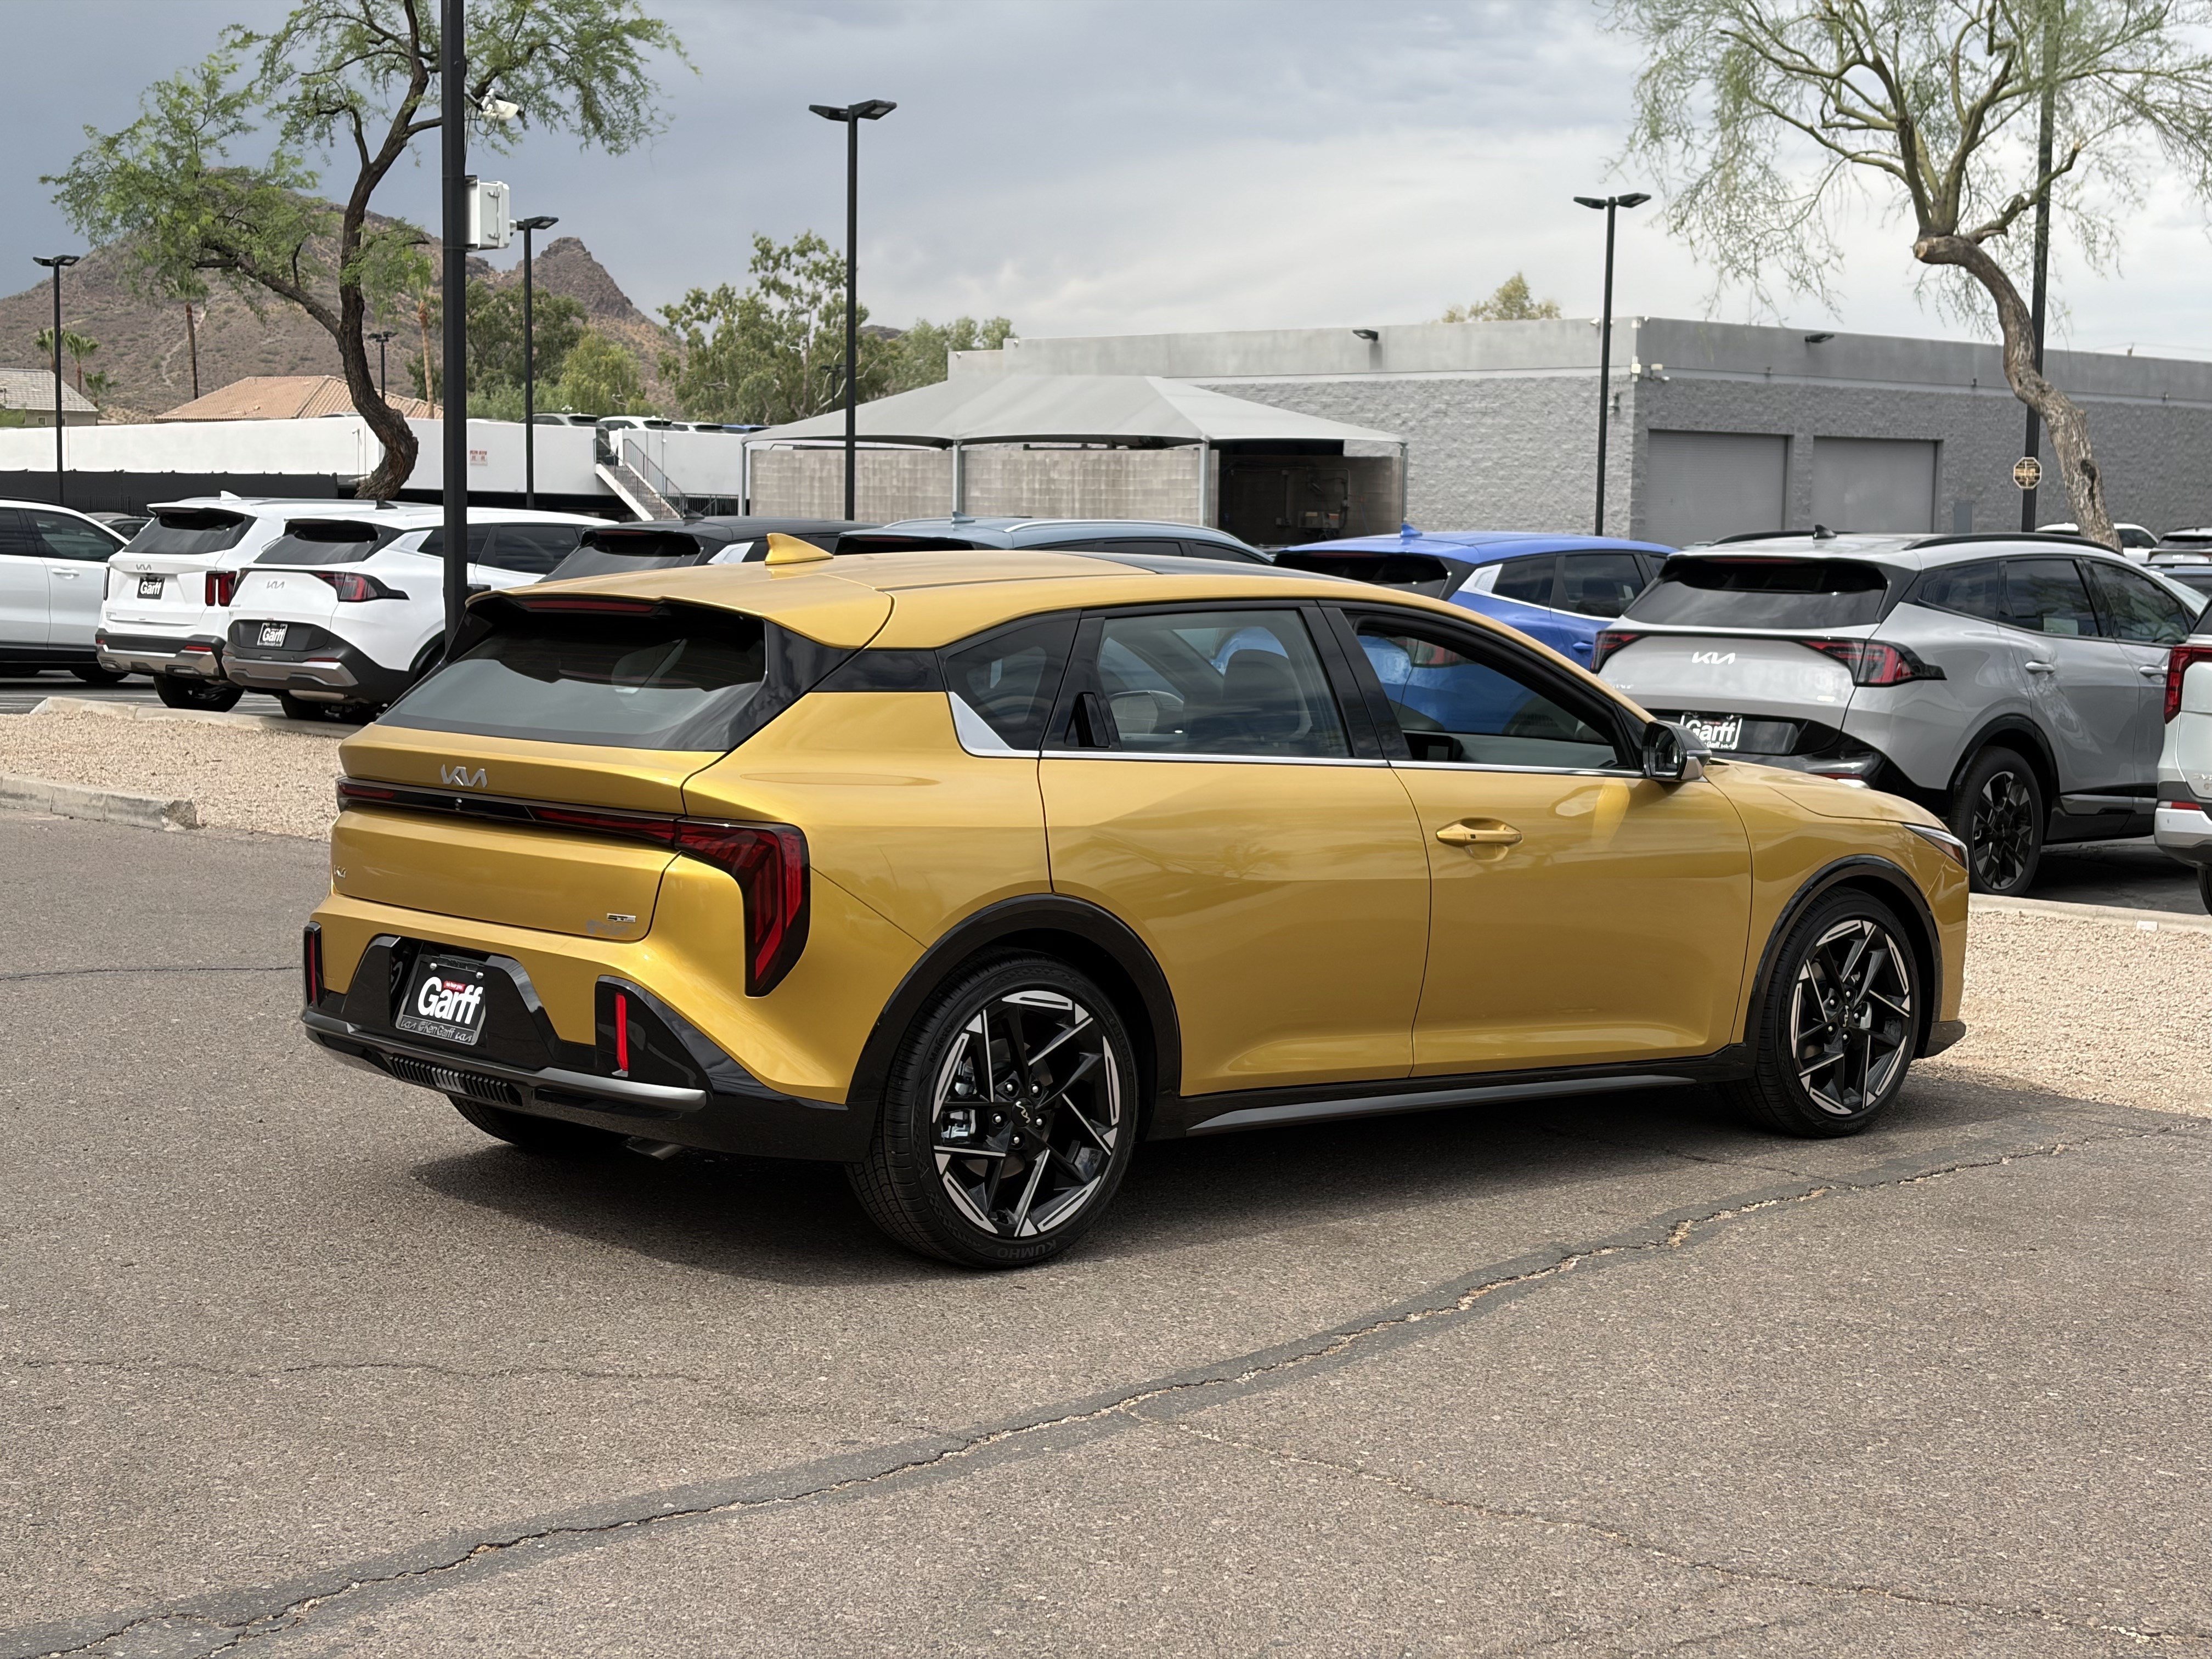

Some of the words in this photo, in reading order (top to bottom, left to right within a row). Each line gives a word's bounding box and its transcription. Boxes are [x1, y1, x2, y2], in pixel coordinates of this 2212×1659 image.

[140, 581, 162, 595] Garff
[266, 580, 285, 589] KIA
[262, 628, 285, 642] Garff
[1692, 651, 1735, 664] KIA
[1686, 719, 1736, 742] Garff
[441, 764, 488, 787] KIA
[418, 977, 483, 1024] Garff
[437, 1025, 455, 1039] Garff
[997, 1239, 1056, 1258] KUMHO
